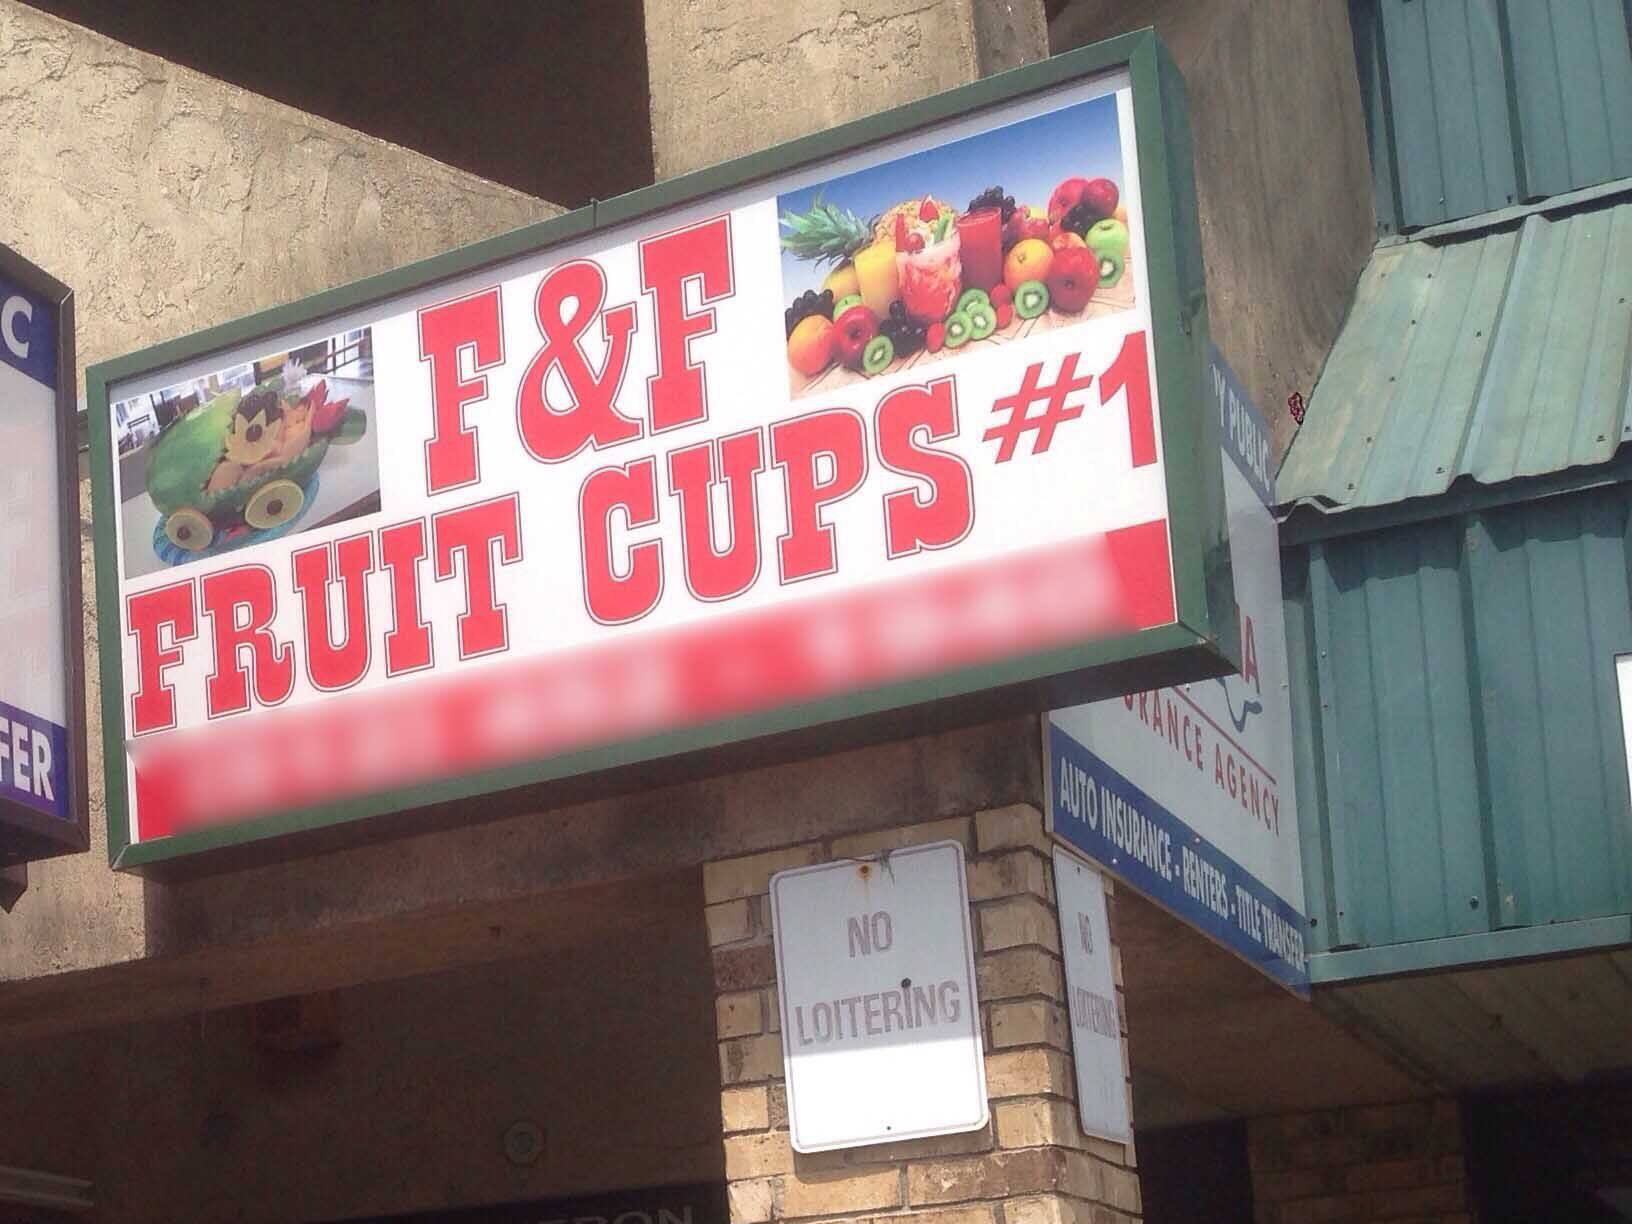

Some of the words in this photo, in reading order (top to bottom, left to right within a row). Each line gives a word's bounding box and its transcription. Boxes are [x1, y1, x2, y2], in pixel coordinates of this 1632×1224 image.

[418, 215, 732, 495] F&F
[1229, 388, 1272, 493] PUBLIC
[127, 495, 521, 736] FRUIT
[581, 376, 975, 626] CUPS
[983, 330, 1161, 467] #1
[1215, 743, 1279, 836] AGENCY
[1061, 757, 1097, 830] AUTO
[1102, 786, 1172, 882] INSURANCE
[1182, 845, 1229, 920] RENTERS
[1236, 885, 1261, 942] TITLE
[1261, 905, 1306, 973] TRANSFER
[847, 910, 893, 958] NO
[795, 980, 961, 1047] LOITERING
